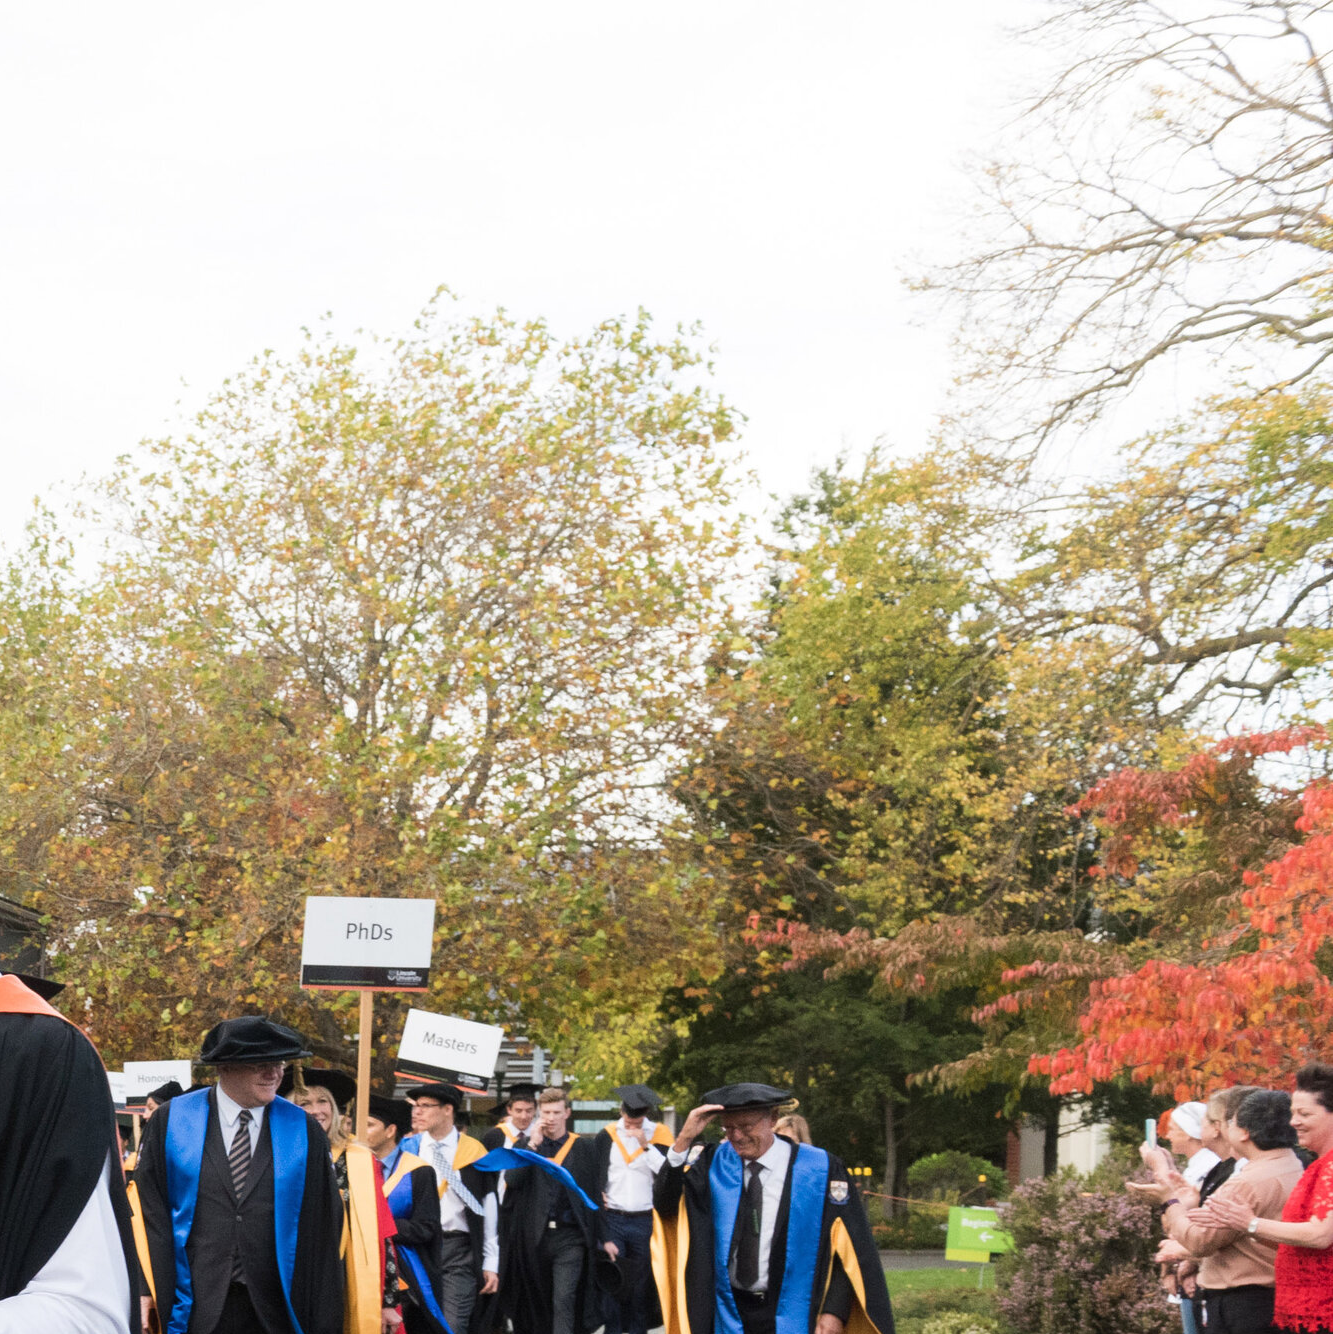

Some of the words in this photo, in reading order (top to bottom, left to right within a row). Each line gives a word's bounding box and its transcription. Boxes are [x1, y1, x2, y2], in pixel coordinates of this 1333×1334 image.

[346, 922, 393, 941] PhDs
[422, 1031, 478, 1054] Masters
[137, 1074, 178, 1084] Honours
